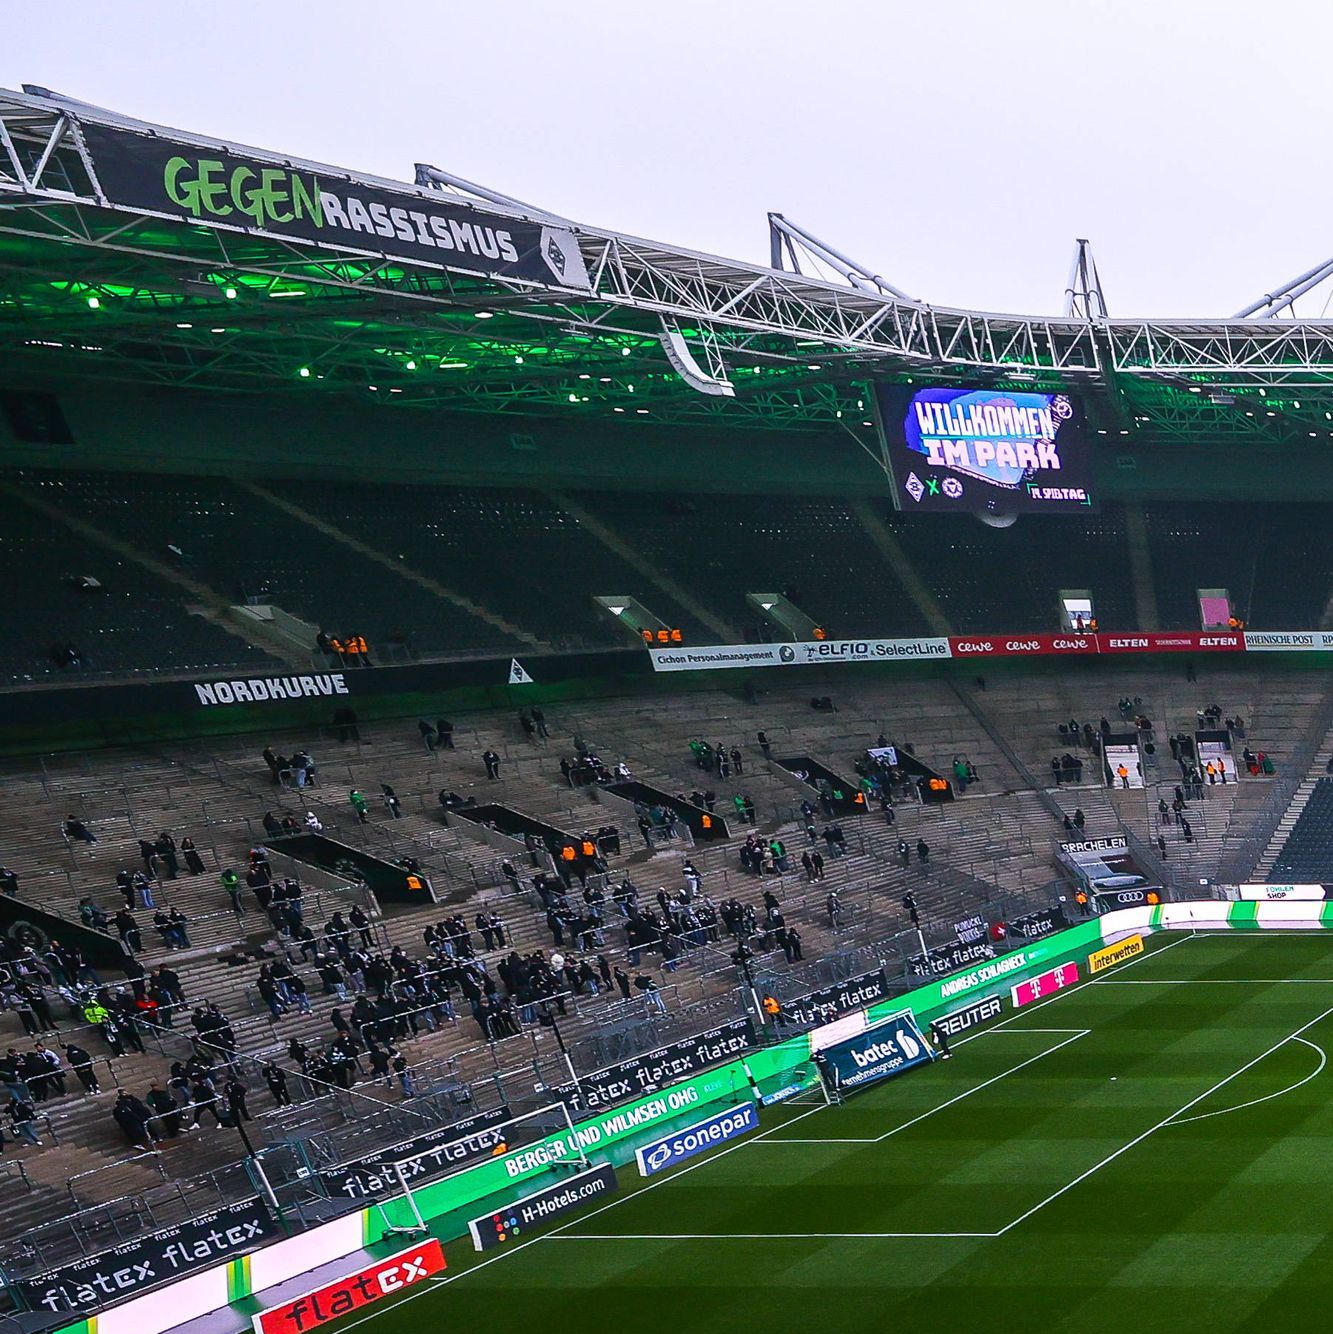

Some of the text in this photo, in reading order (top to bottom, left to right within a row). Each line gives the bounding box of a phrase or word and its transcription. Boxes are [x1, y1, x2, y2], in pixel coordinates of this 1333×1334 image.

[915, 401, 1056, 441] WILLKOMMEN
[923, 438, 1061, 470] IM PARK
[957, 640, 994, 652] cewe
[1005, 639, 1042, 651] cewe
[1053, 638, 1089, 650] cewe
[1109, 638, 1149, 648] ELTEN
[1199, 637, 1238, 646] ELTEN
[1245, 634, 1313, 645] RHEINISCHE POST
[876, 641, 947, 656] SelectLine
[657, 651, 775, 665] Cichon Personalmanagement
[194, 674, 350, 705] NORDKURVE
[1061, 838, 1127, 854] BRACHELEN
[1265, 885, 1295, 894] FOHLEN
[1266, 892, 1288, 901] SHOP
[1093, 940, 1141, 973] interwetten
[941, 974, 979, 999] ANDREAS
[979, 952, 1027, 984] SCHLAGHECK
[939, 999, 1002, 1036] REUTER
[850, 1037, 899, 1068] batec
[503, 1085, 698, 1177] BERGER UND WILMSEN OHG
[674, 1109, 752, 1152] sonepar
[522, 1176, 606, 1225] H-Hotels.com
